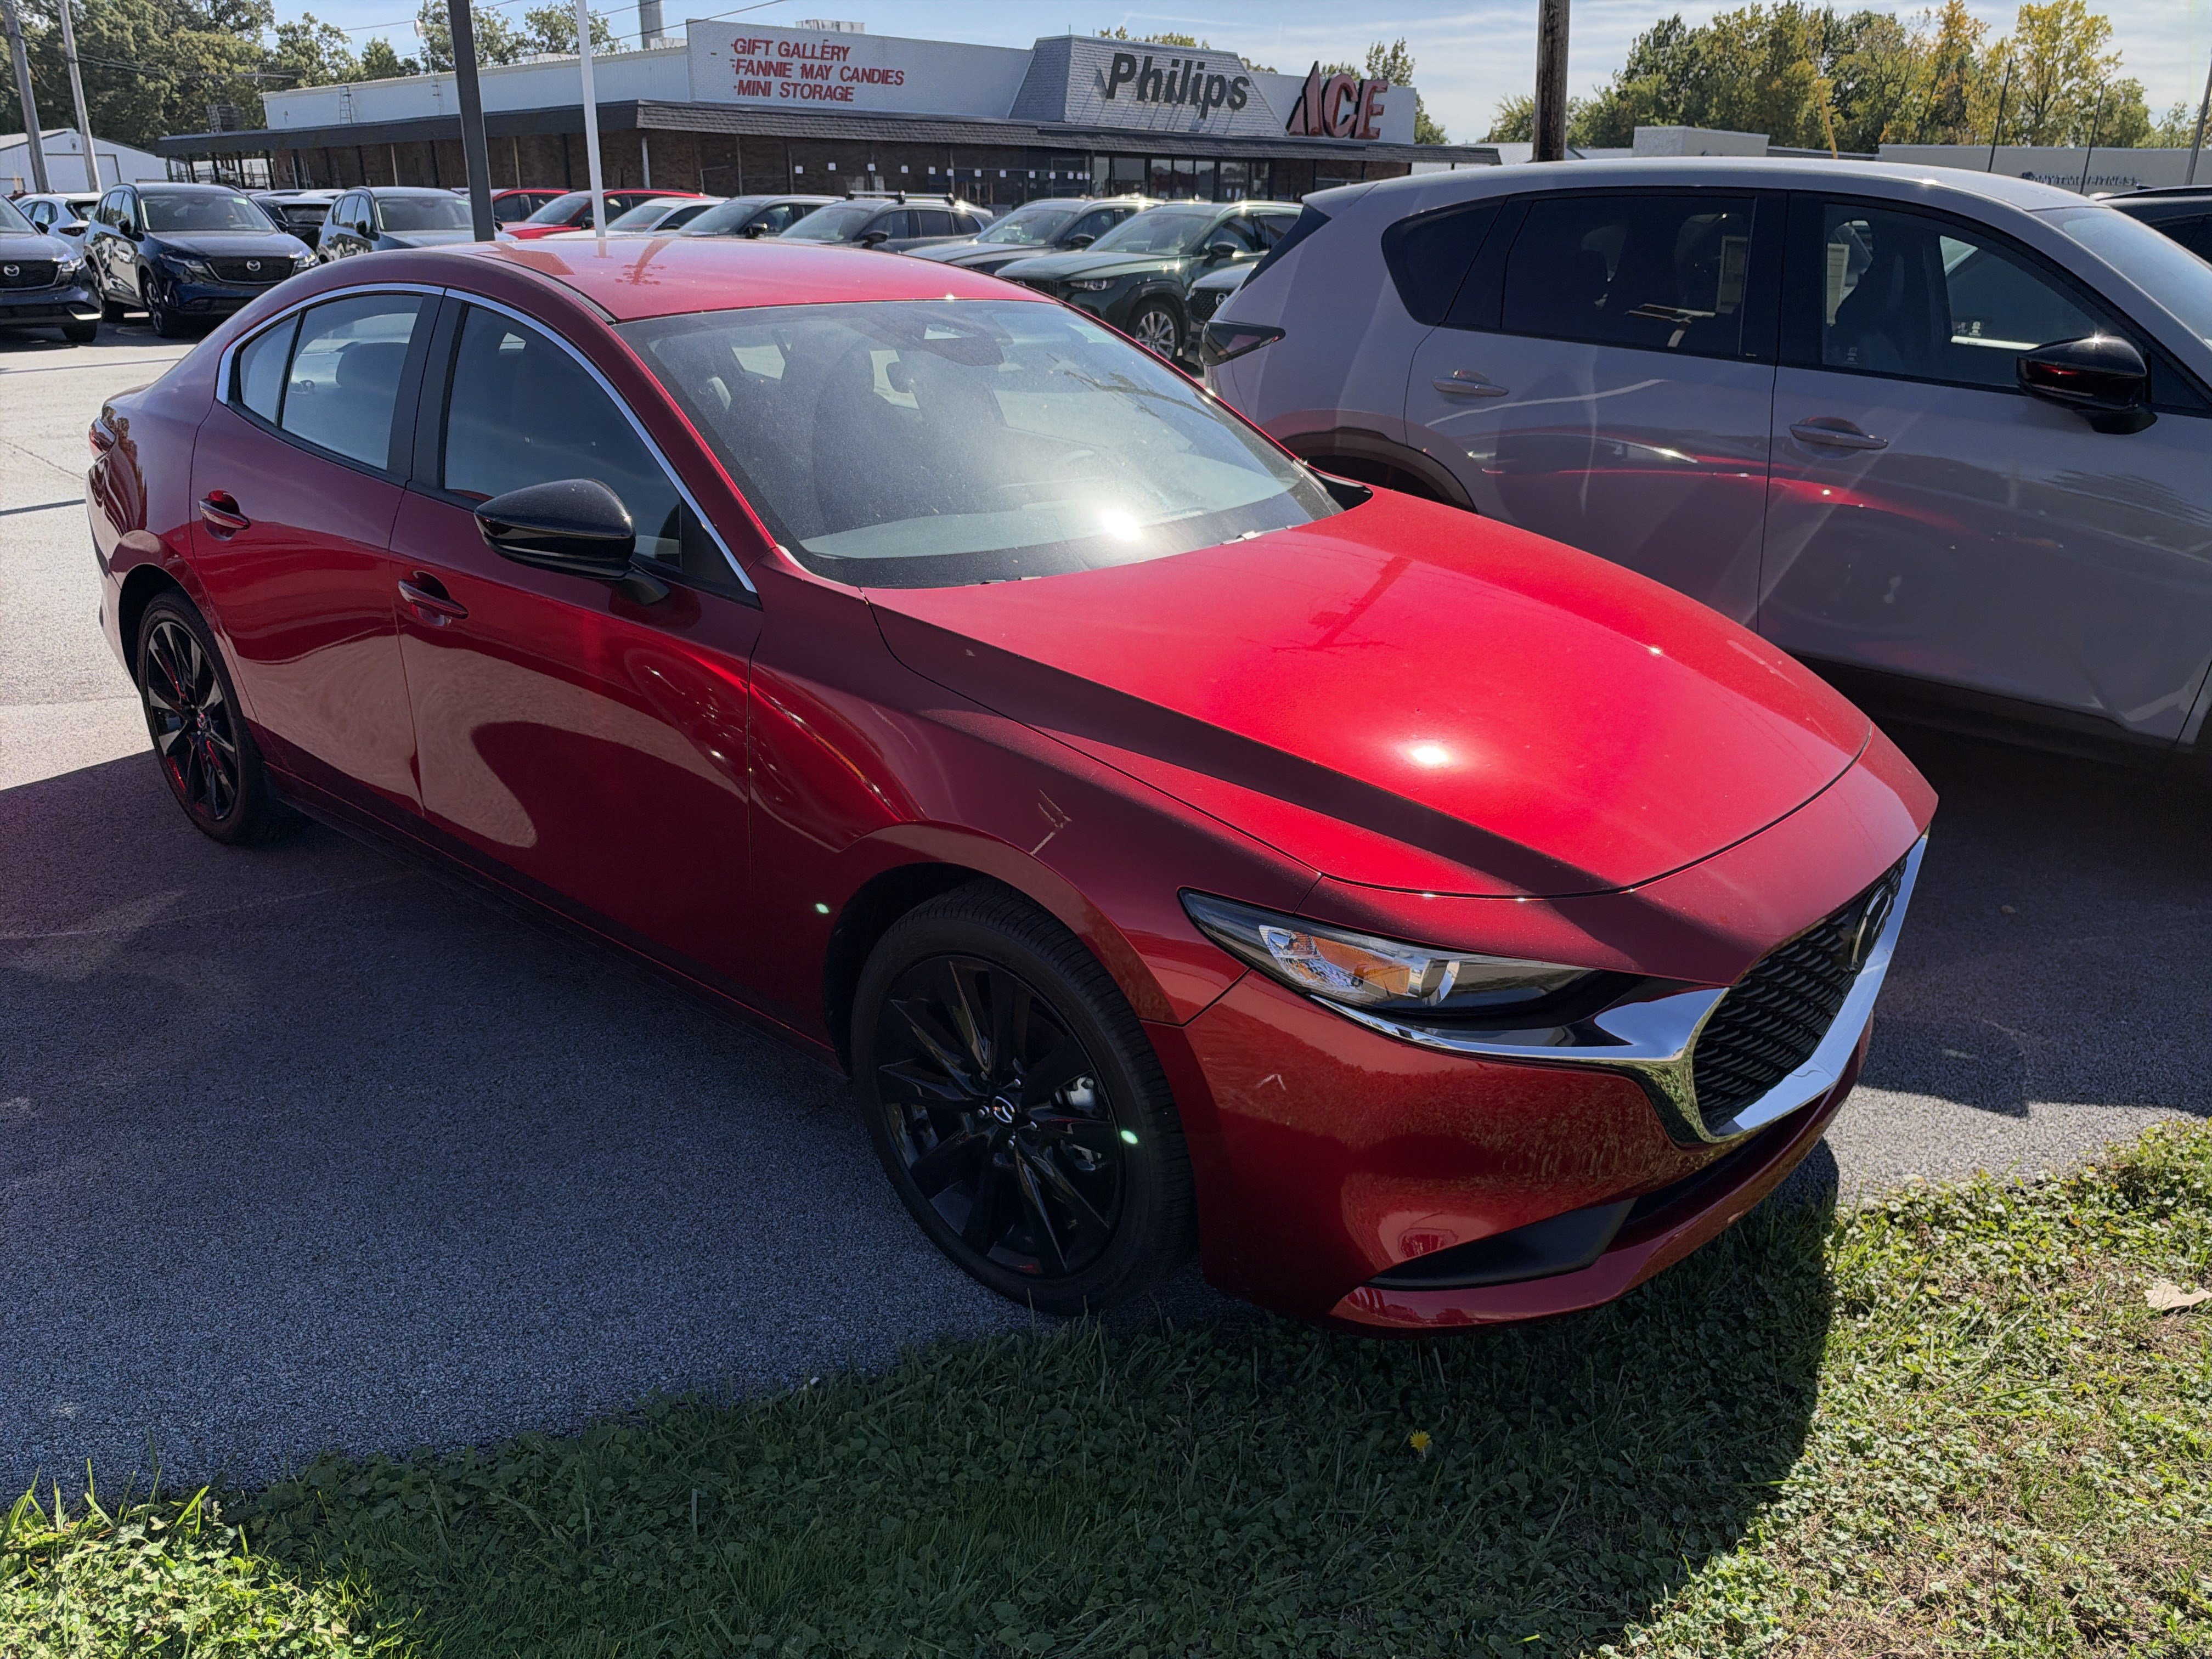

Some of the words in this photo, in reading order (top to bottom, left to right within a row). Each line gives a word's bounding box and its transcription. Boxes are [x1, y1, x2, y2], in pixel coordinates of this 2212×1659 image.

[733, 38, 774, 55] GIFT
[778, 41, 851, 61] GALLERY
[735, 59, 793, 78] FANNIE
[800, 64, 833, 80] MAY
[840, 66, 905, 86] CANDIES
[1105, 53, 1250, 119] Philips
[737, 80, 772, 97] MINI
[780, 82, 855, 101] STORAGE
[1286, 60, 1388, 140] ACE
